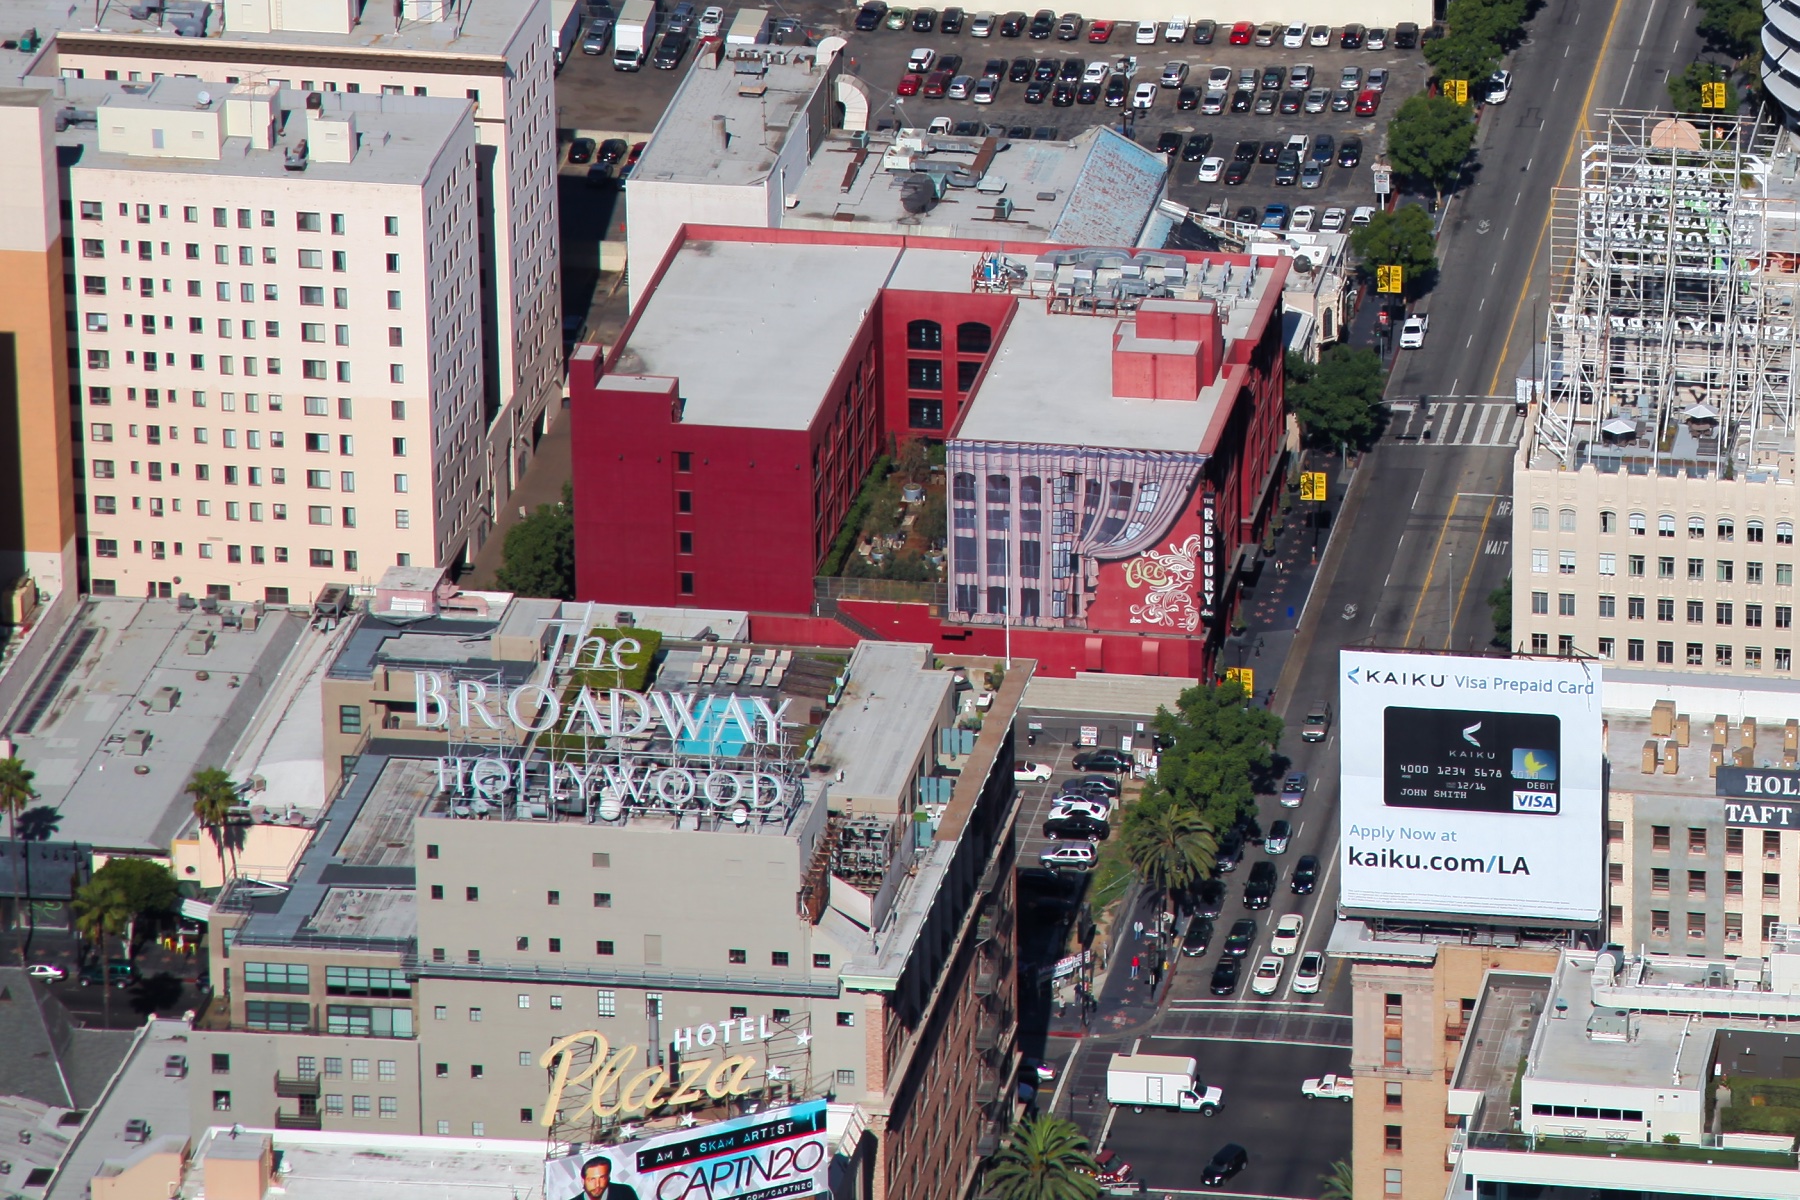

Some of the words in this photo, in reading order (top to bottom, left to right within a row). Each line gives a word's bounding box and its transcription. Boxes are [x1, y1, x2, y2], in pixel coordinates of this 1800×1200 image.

[1204, 507, 1215, 605] REDBURY
[1484, 540, 1509, 555] WAIT
[535, 600, 642, 710] The
[1366, 669, 1445, 688] KAIKU
[1454, 674, 1487, 690] Visa
[1493, 677, 1553, 694] Prepaid
[1557, 679, 1594, 695] Card
[414, 670, 794, 745] BROADWAY
[1449, 750, 1496, 760] KAIKU
[436, 756, 784, 809] HOLLYWOOD
[1400, 764, 1429, 774] 4000
[1437, 766, 1466, 776] 1234
[1474, 768, 1502, 778] 5678
[1400, 788, 1427, 797] JOHN
[1433, 790, 1467, 799] SMITH
[1457, 781, 1487, 791] 12/16
[1526, 781, 1555, 790] DEBIT
[1515, 794, 1554, 808] VISA
[1725, 803, 1793, 825] TAFT
[1349, 824, 1395, 842] Apply
[1400, 827, 1437, 841] Now
[1440, 830, 1458, 842] at
[1348, 846, 1531, 876] kaiku.com/LA
[673, 1014, 774, 1051] HOTEL
[539, 1029, 757, 1128] Plaza
[638, 1155, 645, 1168] I
[655, 1151, 673, 1163] AM
[682, 1146, 692, 1158] A
[699, 1136, 736, 1153] SKAM
[743, 1122, 795, 1144] ARTIST
[656, 1140, 826, 1200] CAPTN20
